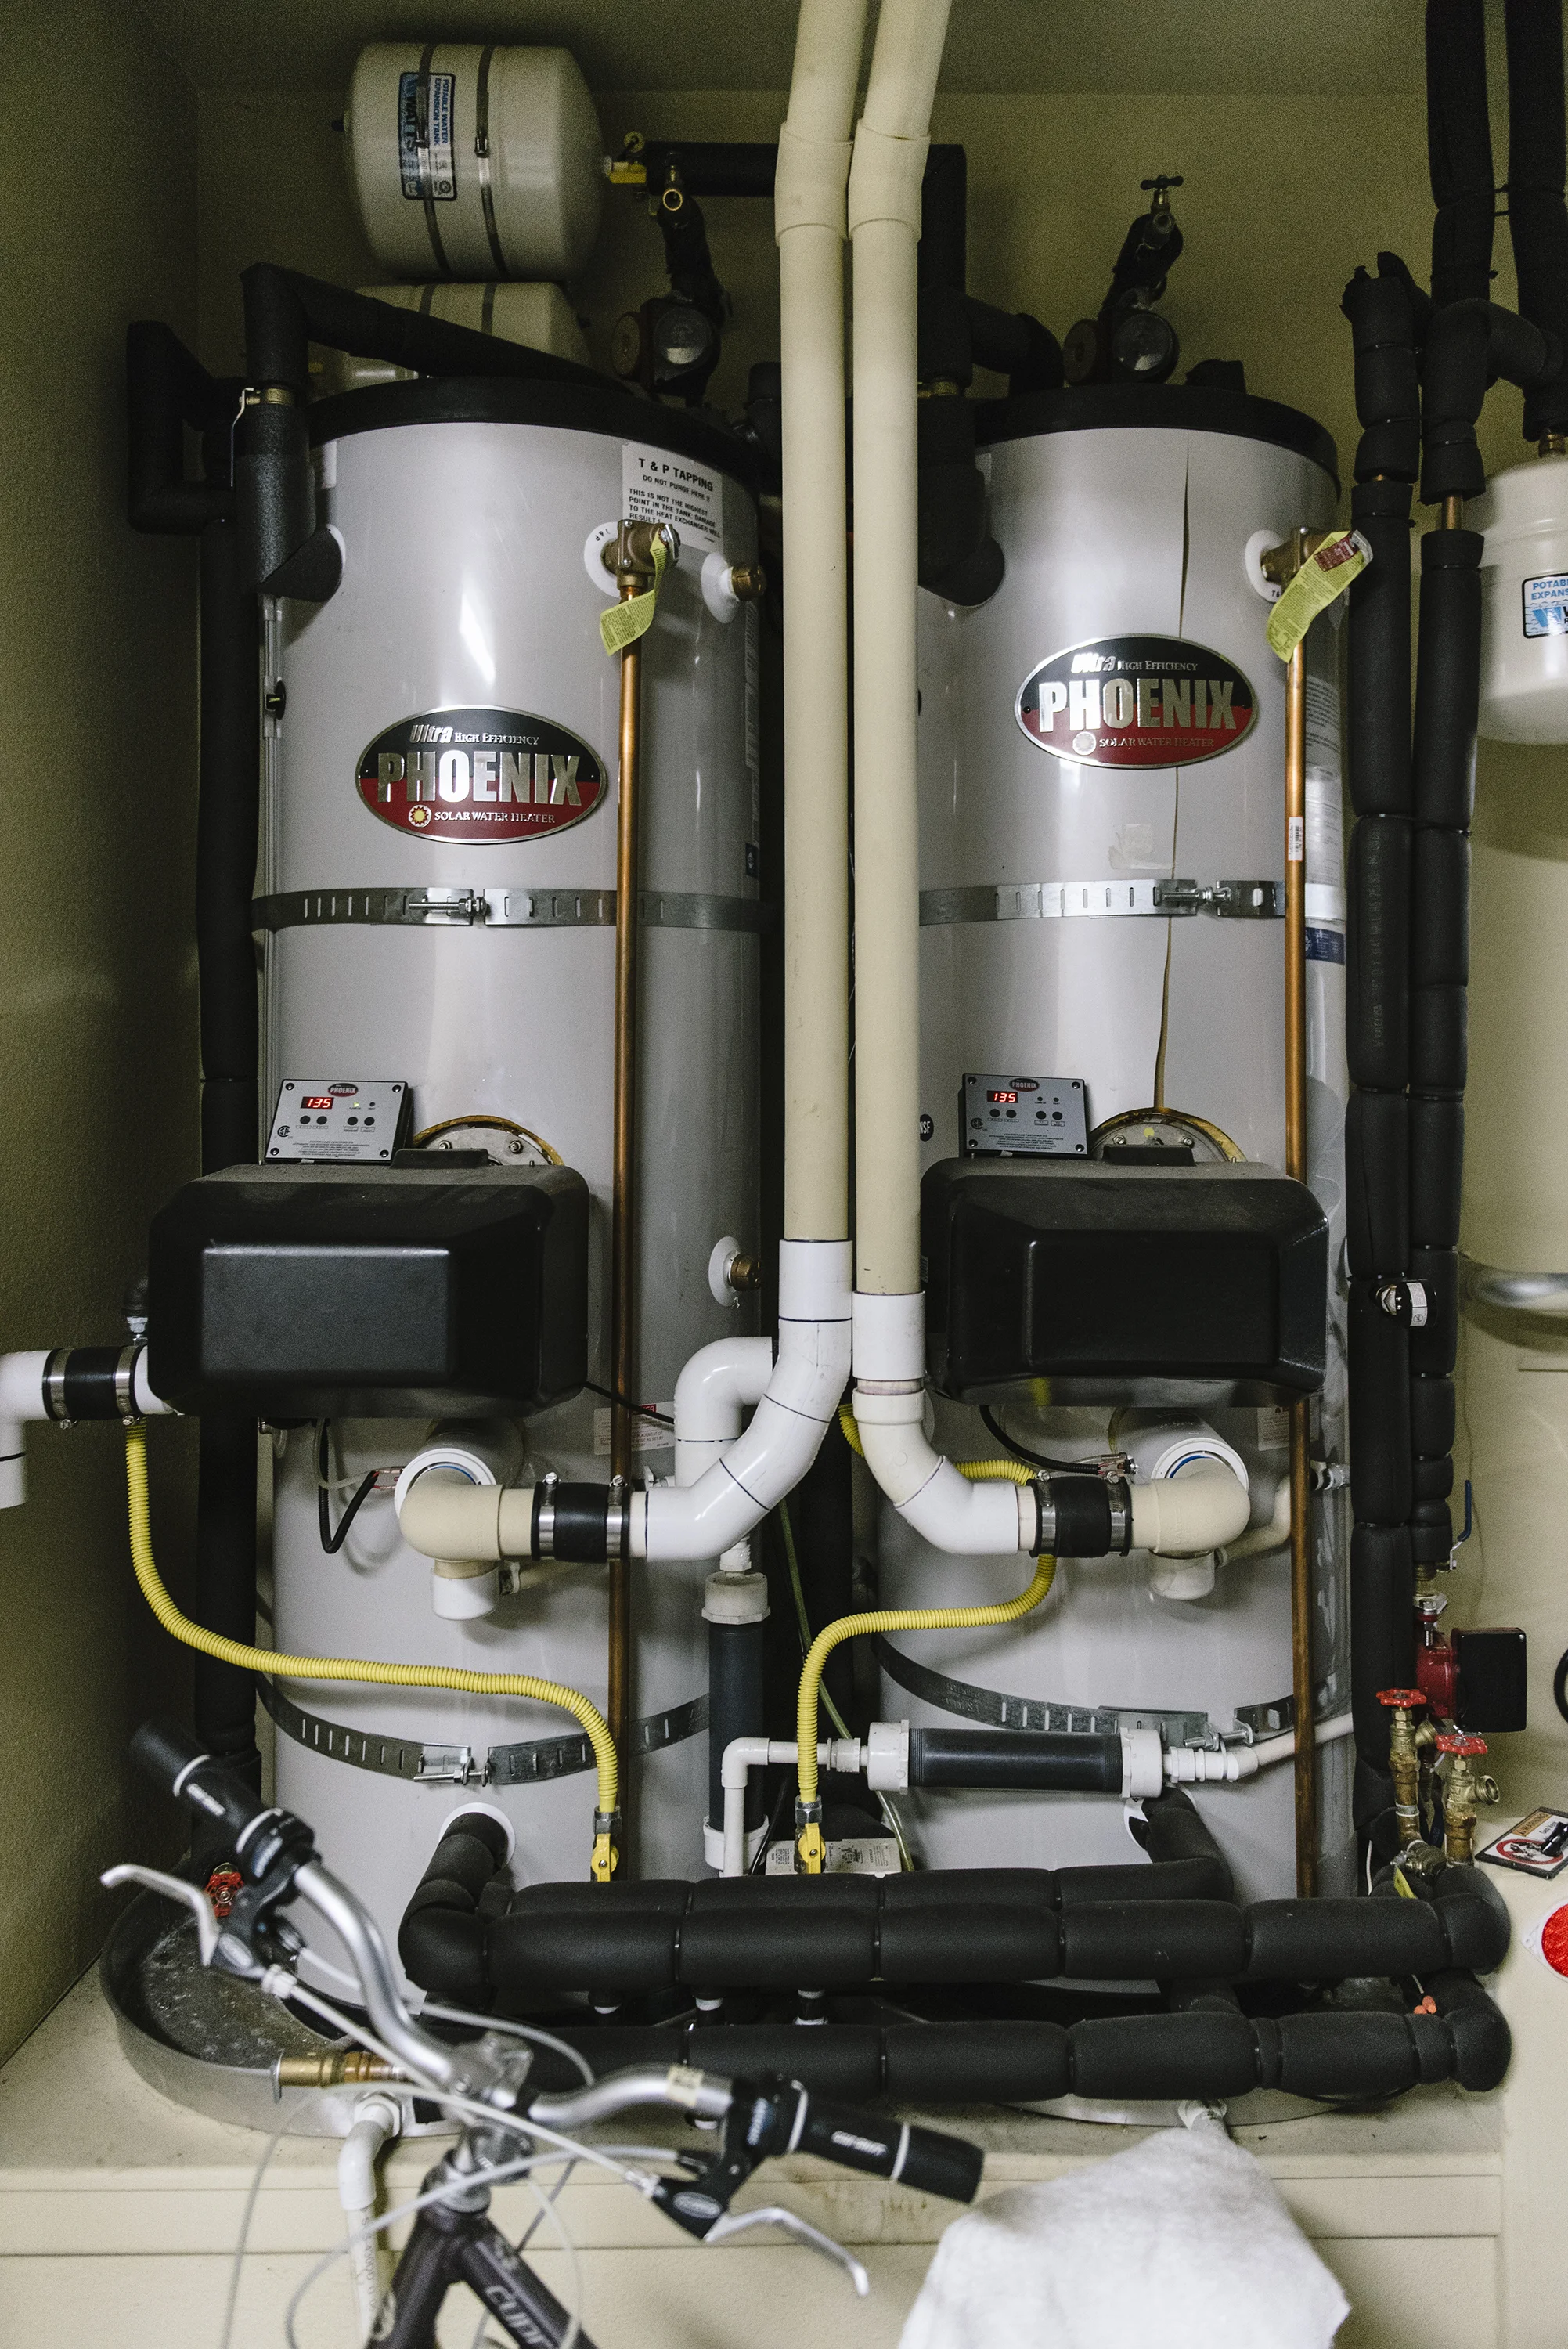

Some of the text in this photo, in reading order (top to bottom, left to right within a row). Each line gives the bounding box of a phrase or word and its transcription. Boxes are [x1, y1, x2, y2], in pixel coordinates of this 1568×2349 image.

[433, 78, 442, 121] EXPANSION
[639, 458, 714, 492] T & P TAPPING
[654, 478, 667, 486] NOT
[669, 482, 690, 494] PURGE
[691, 489, 707, 500] HERE
[629, 488, 645, 496] THIS
[671, 499, 683, 507] THE
[684, 503, 708, 515] HIGHEST
[629, 496, 650, 506] POINT
[661, 504, 673, 513] THE
[694, 514, 716, 527] DAMAGE
[629, 513, 655, 523] RESULT
[656, 511, 672, 520] HEAT
[674, 516, 708, 532] EXCHANGER
[1071, 652, 1198, 673] Ultra HIGH EFFICIENCY
[1039, 678, 1237, 733] PHOENIX
[409, 724, 540, 745] Ultra HIGH EFFICIENCY
[1099, 738, 1214, 748] SOLAR WATER HEATER
[377, 749, 582, 806] PHOENIX
[434, 811, 555, 824] SOLAR WATER HEATER
[308, 1098, 332, 1108] 135
[993, 1092, 1016, 1102] 135
